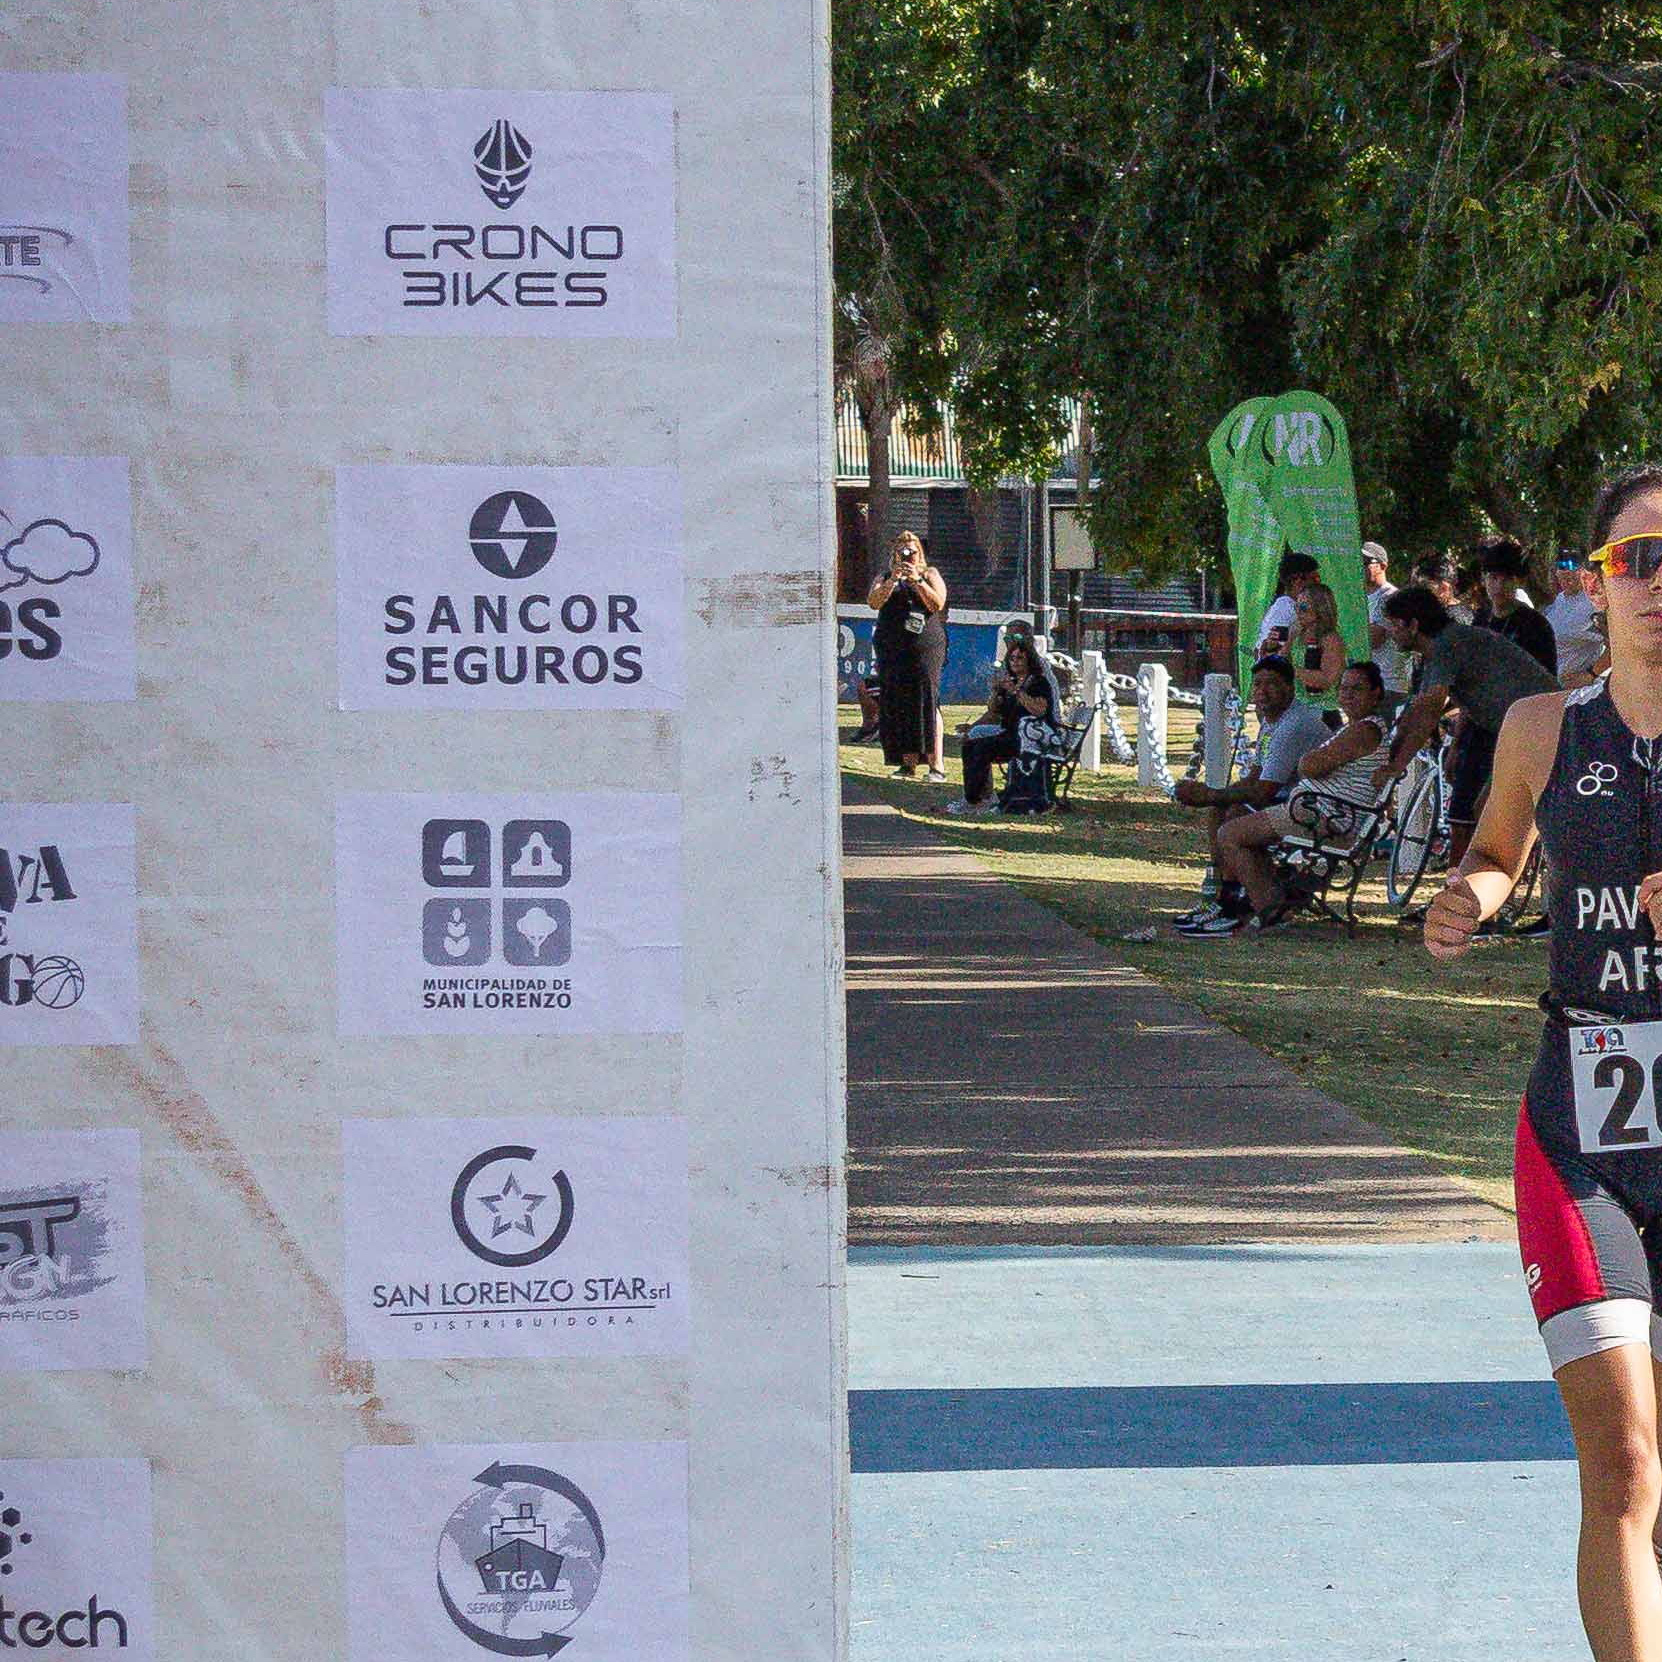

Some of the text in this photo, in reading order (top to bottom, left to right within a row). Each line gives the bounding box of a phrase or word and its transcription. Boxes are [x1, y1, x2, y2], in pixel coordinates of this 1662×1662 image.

[385, 224, 623, 260] CRONO
[402, 271, 608, 307] BIKES
[384, 594, 642, 635] SANCOR
[385, 644, 643, 685] SEGUROS
[423, 978, 571, 990] MUNICIPALIDAD DE
[423, 992, 572, 1009] SAN LORENZO
[372, 1284, 430, 1308] SAN
[441, 1280, 575, 1306] LORENZO
[414, 1315, 635, 1332] DISTRIBUIDORA
[495, 1570, 547, 1591] TGA
[523, 1599, 576, 1613] FLUVIALES
